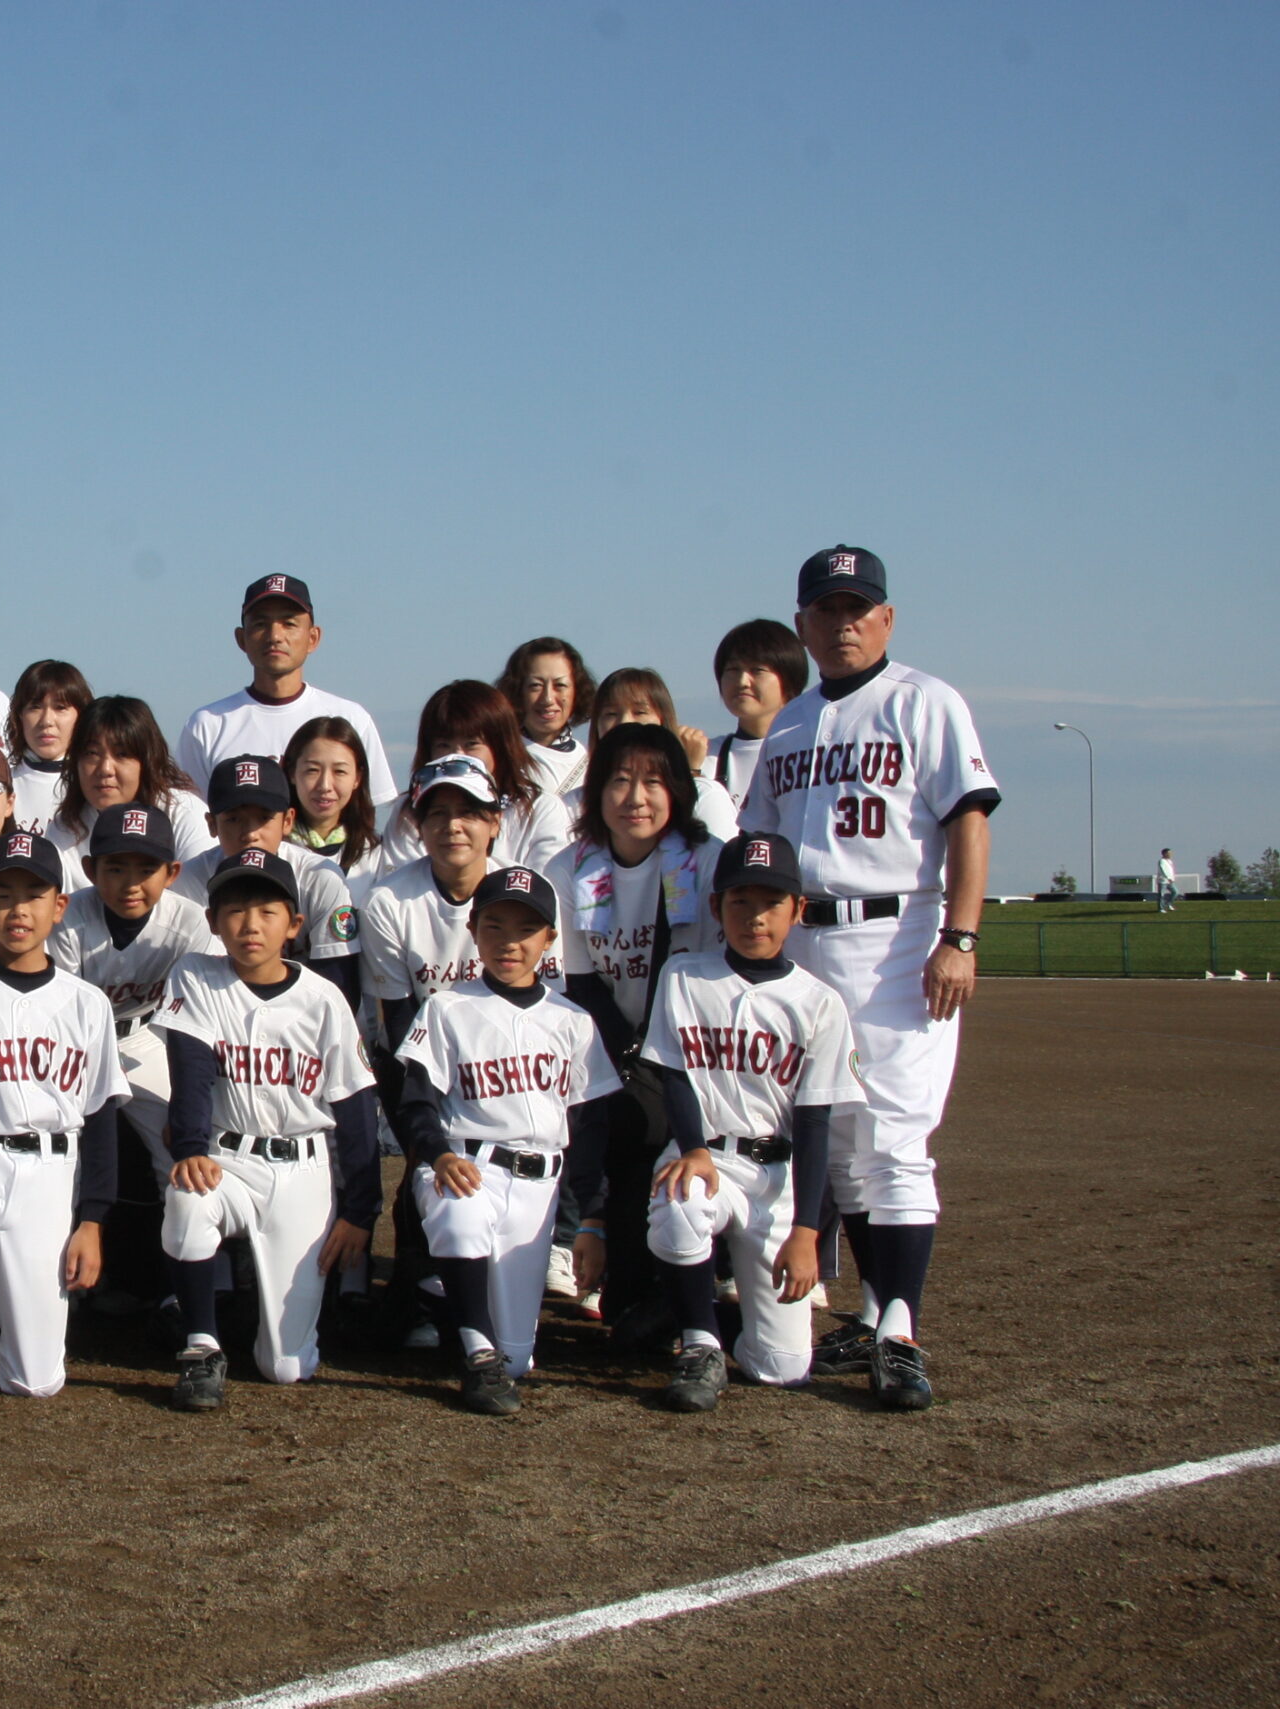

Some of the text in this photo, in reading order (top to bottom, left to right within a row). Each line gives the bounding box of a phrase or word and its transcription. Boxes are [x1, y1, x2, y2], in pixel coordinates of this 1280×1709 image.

[766, 742, 903, 798] NISHICLUB
[835, 796, 886, 838] 30
[591, 954, 650, 981] 山西
